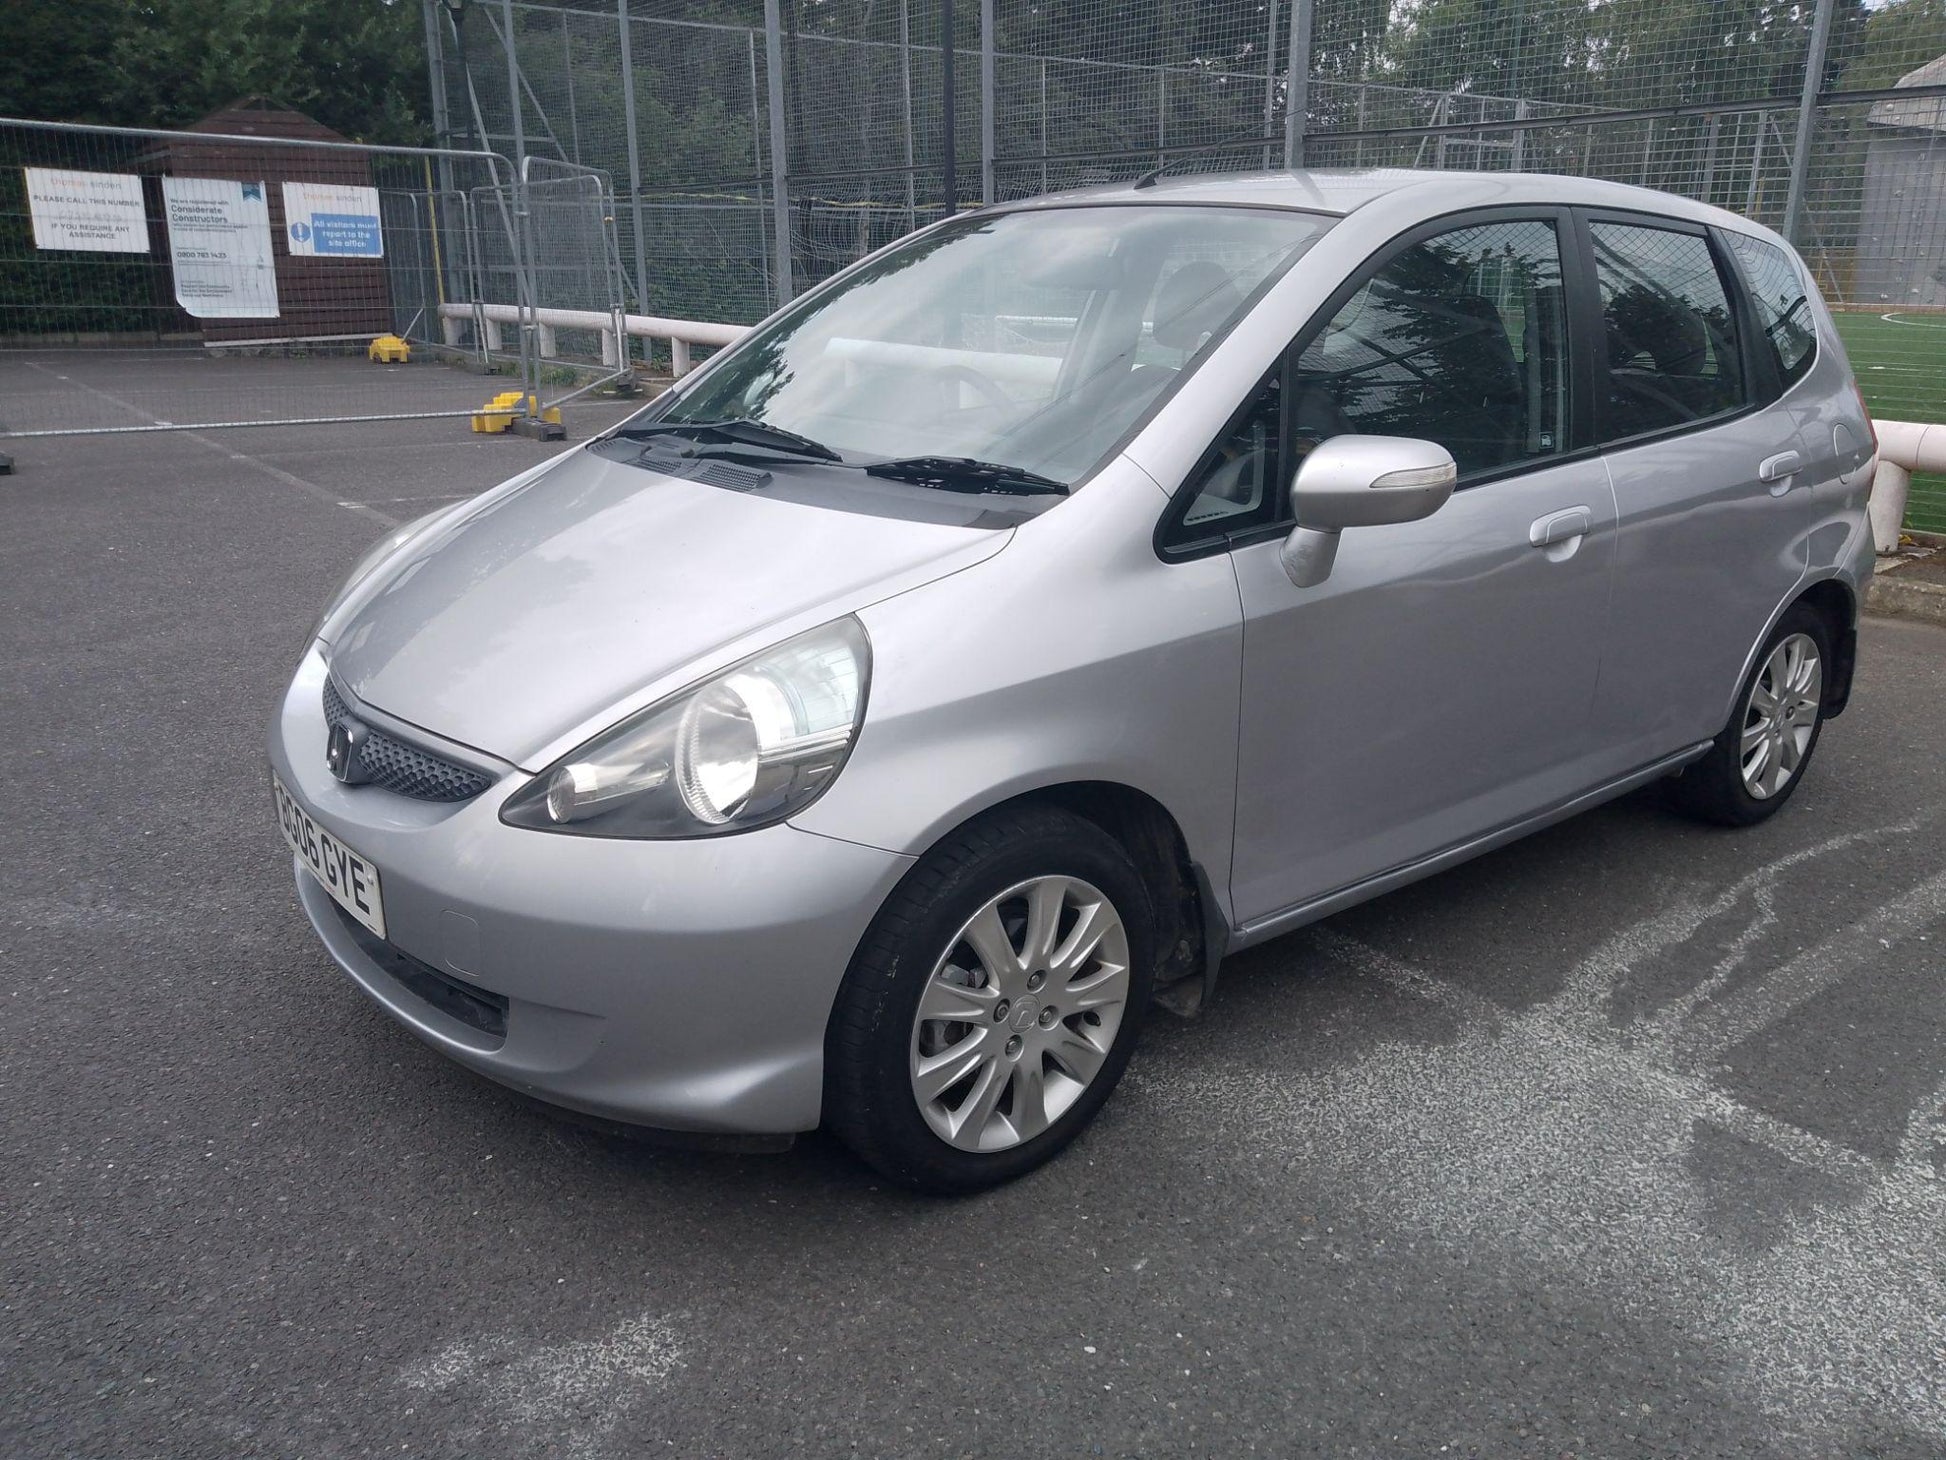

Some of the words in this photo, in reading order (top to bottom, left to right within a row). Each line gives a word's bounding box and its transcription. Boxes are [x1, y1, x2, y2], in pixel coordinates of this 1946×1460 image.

[33, 194, 65, 203] PLEASE
[66, 197, 88, 205] CALL
[89, 198, 107, 206] THIS
[107, 199, 141, 207] NUMBER
[171, 204, 223, 214] Considerate
[172, 213, 228, 223] Constructors
[60, 223, 78, 231] YOU
[80, 224, 112, 232] REQUIRE
[313, 220, 325, 228] All
[69, 231, 116, 240] ASSISTANCE
[322, 231, 347, 239] report
[358, 231, 370, 239] the
[328, 239, 342, 247] site
[344, 240, 367, 248] office
[321, 833, 371, 916] GYE
